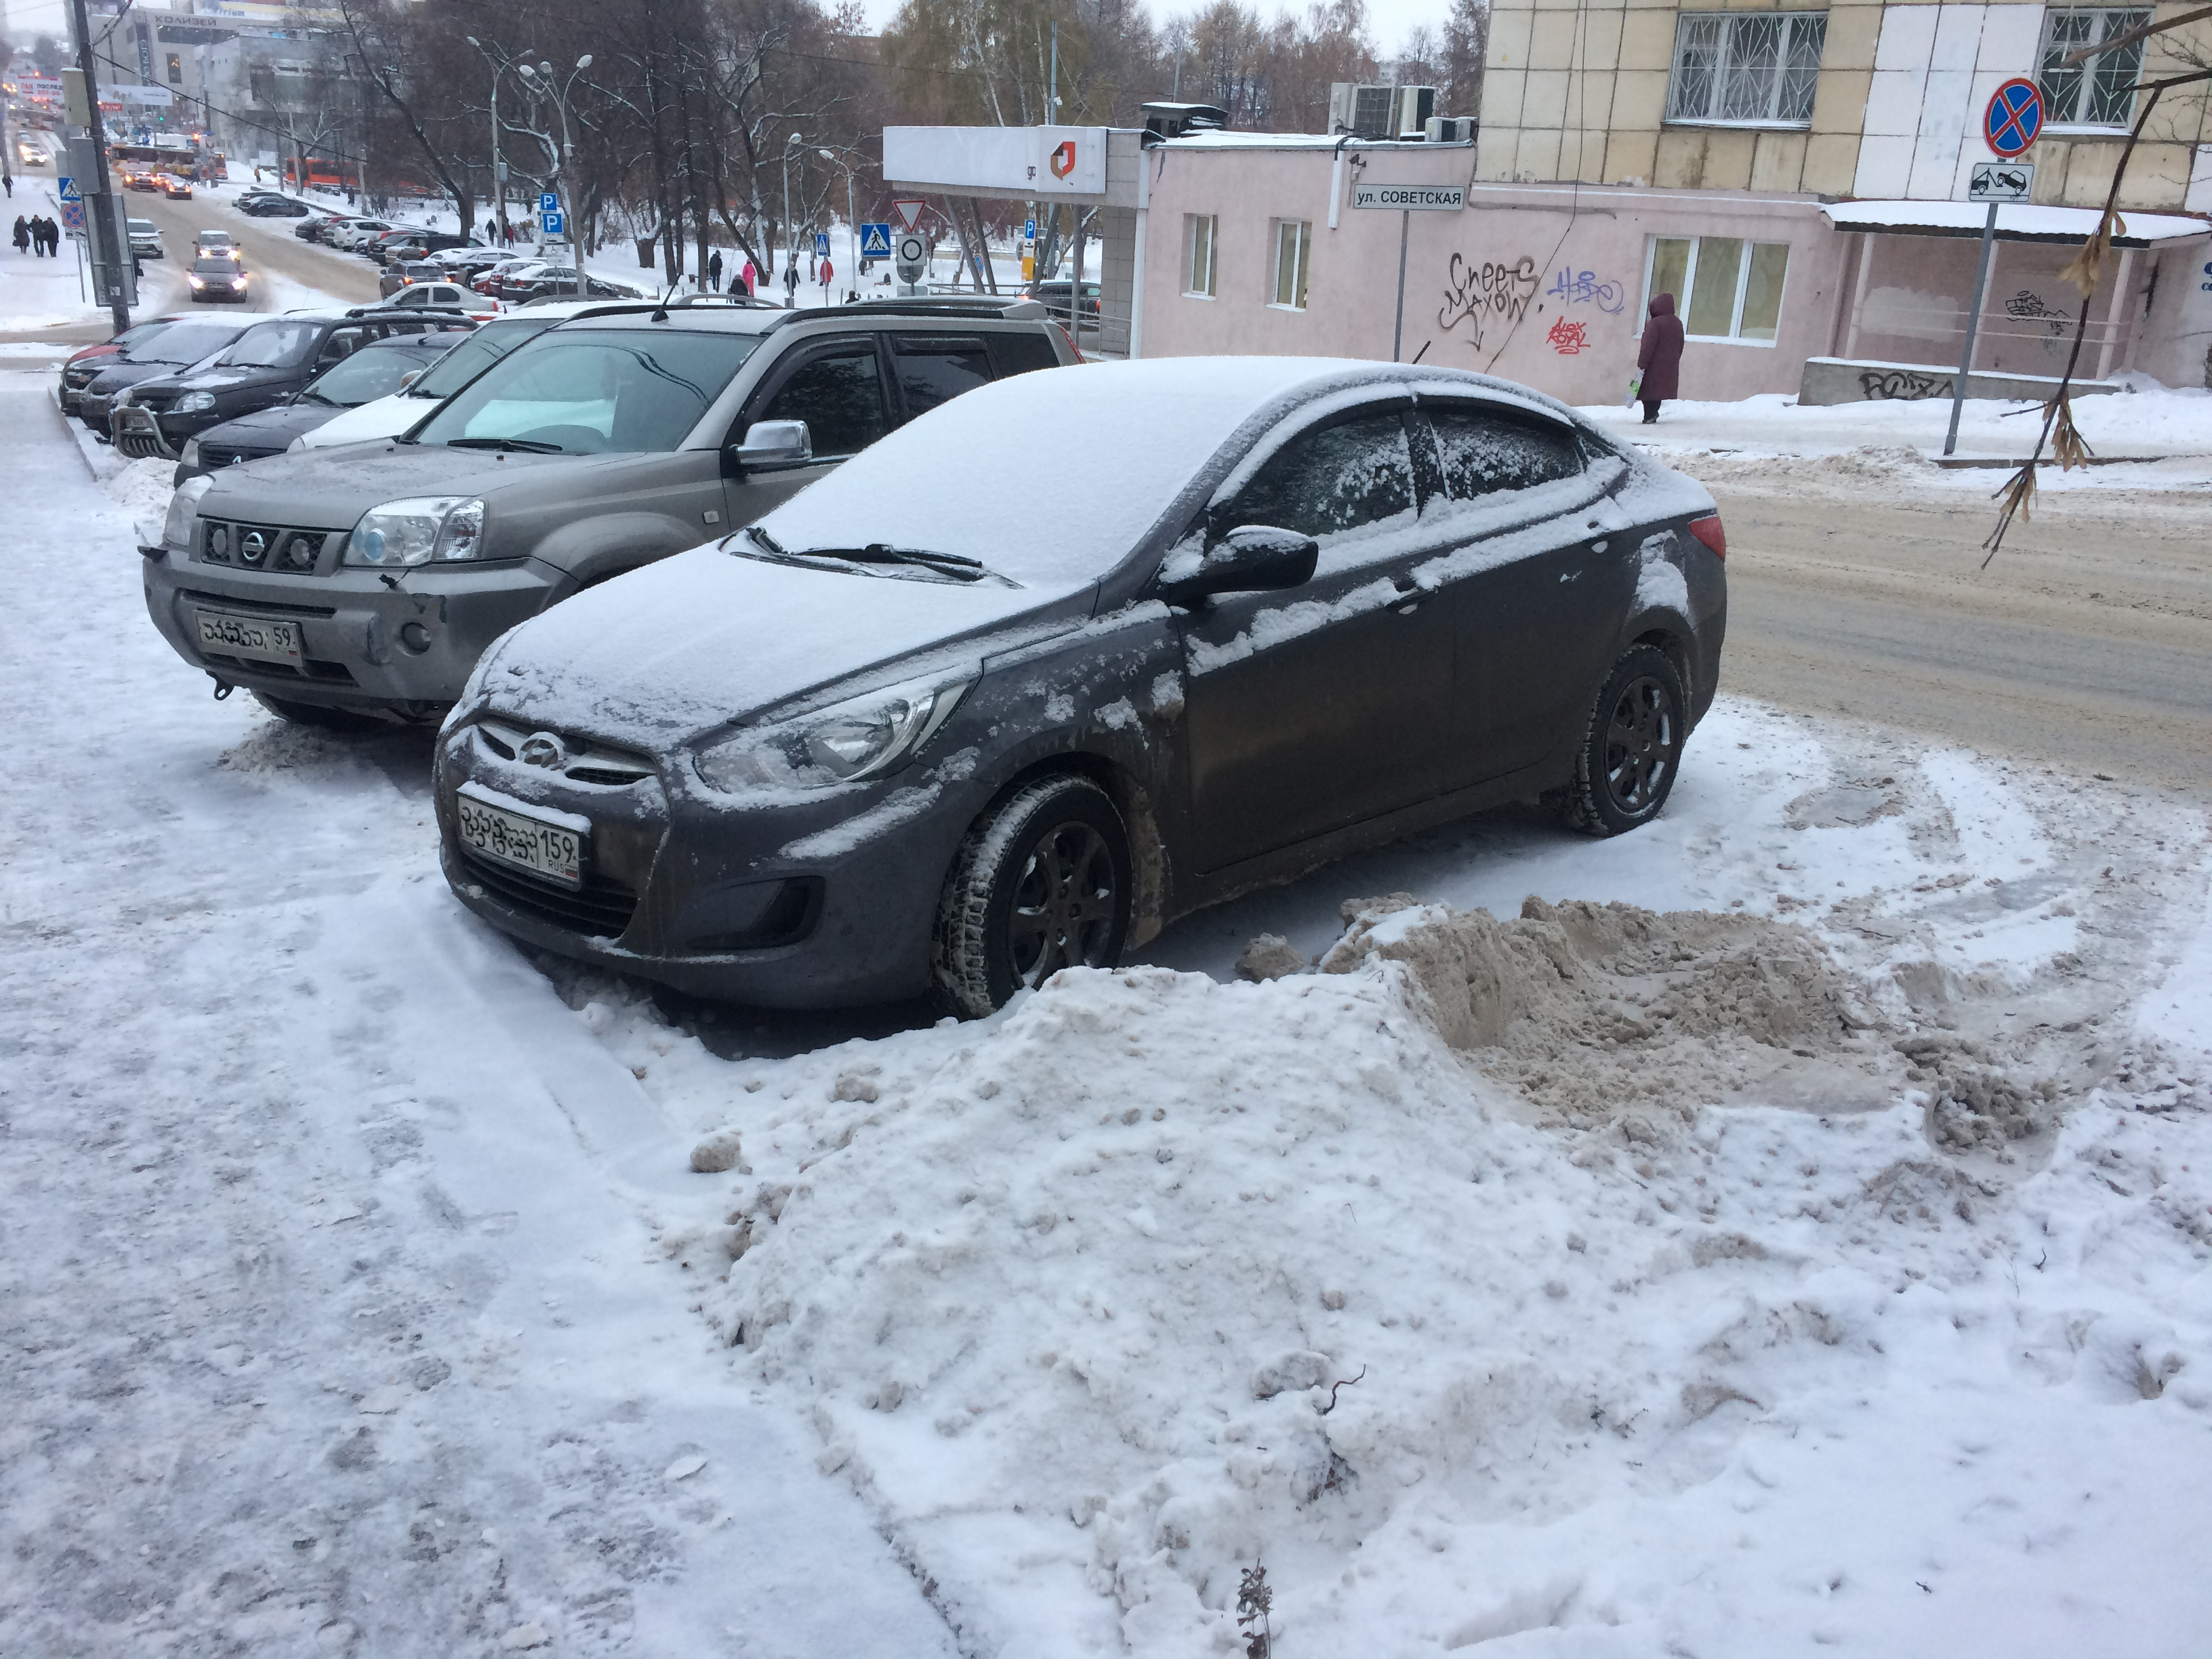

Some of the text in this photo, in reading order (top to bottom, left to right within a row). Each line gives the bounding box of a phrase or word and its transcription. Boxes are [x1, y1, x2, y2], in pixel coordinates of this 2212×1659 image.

[155, 15, 217, 26] КОЛИЗЕЙ
[544, 195, 553, 209] P
[1357, 190, 1461, 205] ул. СОВЕТСКАЯ
[547, 215, 558, 231] P
[1027, 222, 1033, 236] P
[273, 619, 291, 647] 59
[540, 830, 574, 863] 159
[548, 859, 565, 874] RUS
